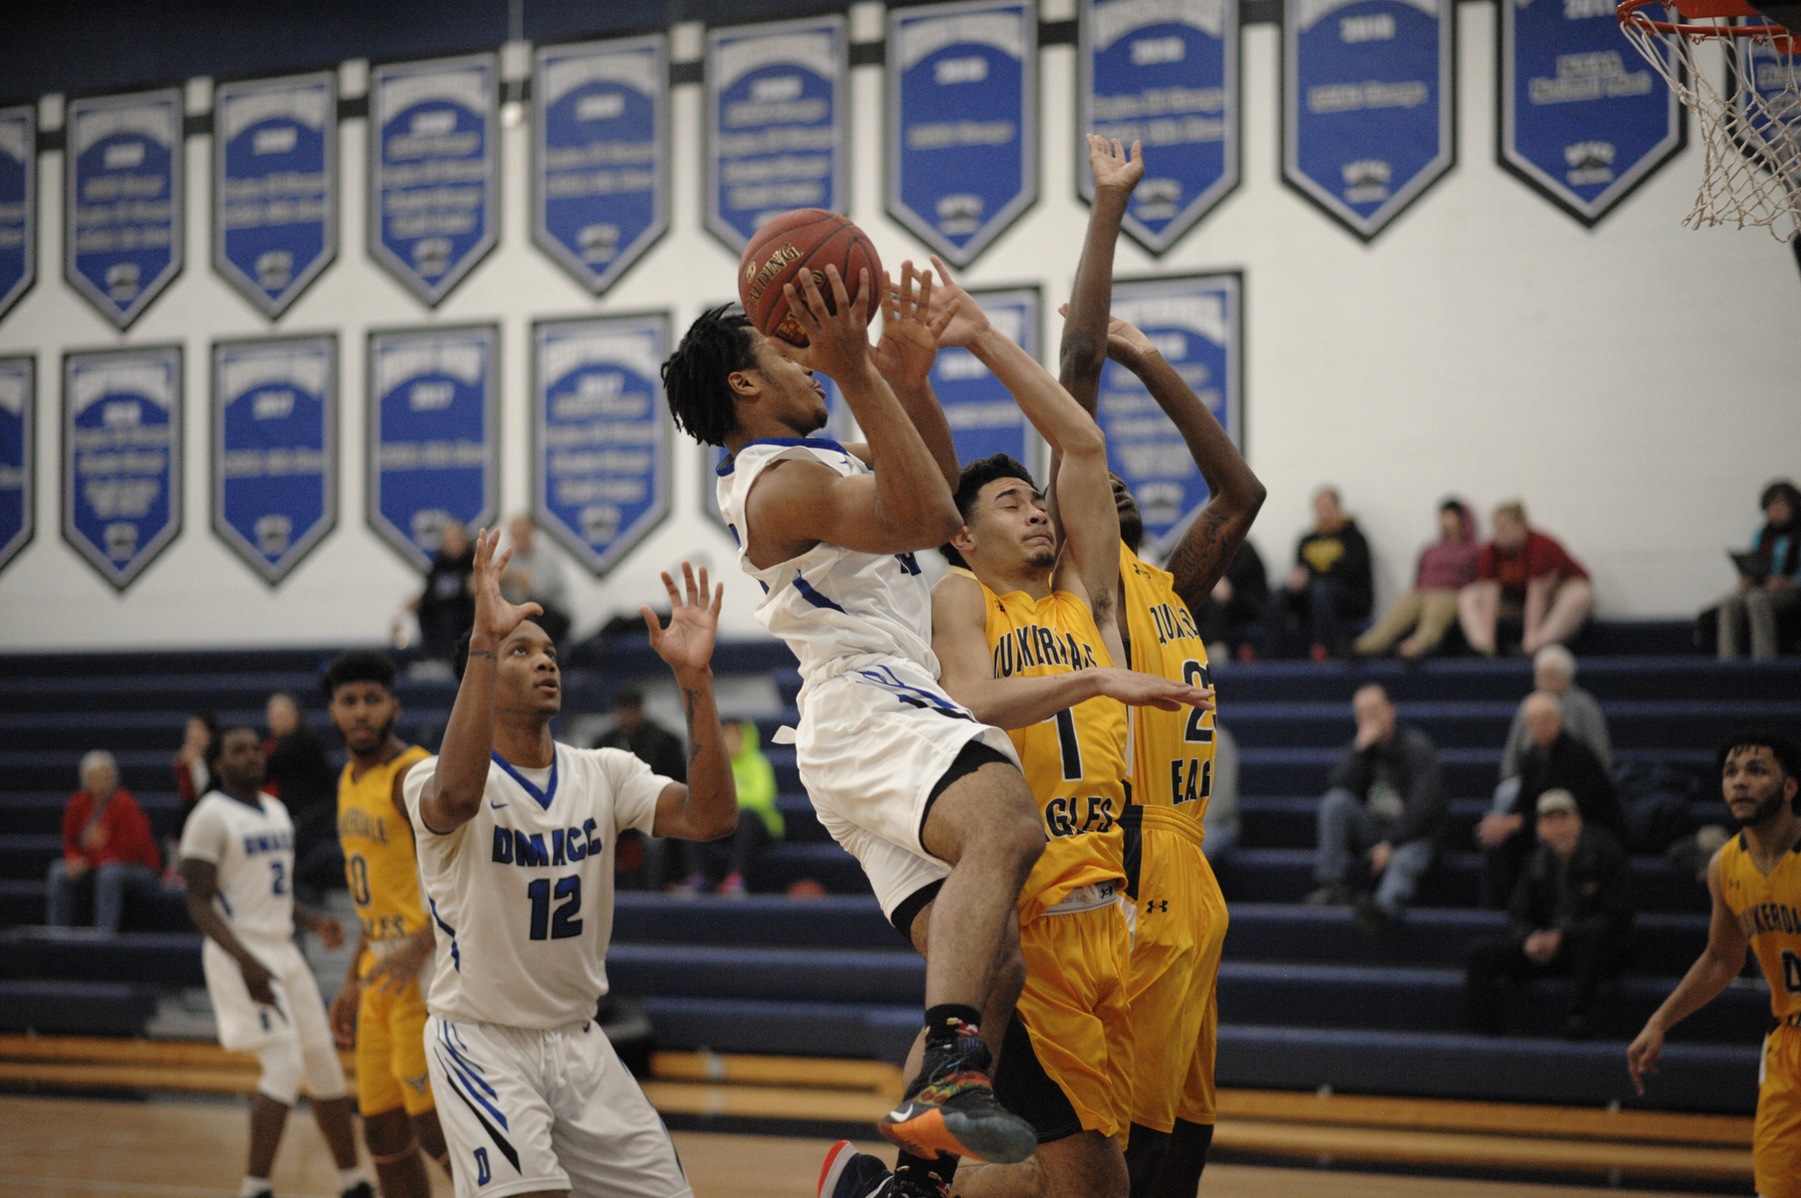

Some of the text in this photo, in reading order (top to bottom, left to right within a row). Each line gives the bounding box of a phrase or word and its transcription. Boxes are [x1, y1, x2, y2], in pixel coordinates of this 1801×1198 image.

[492, 817, 602, 867] DMACC
[527, 874, 583, 941] 12
[473, 1146, 491, 1187] D
